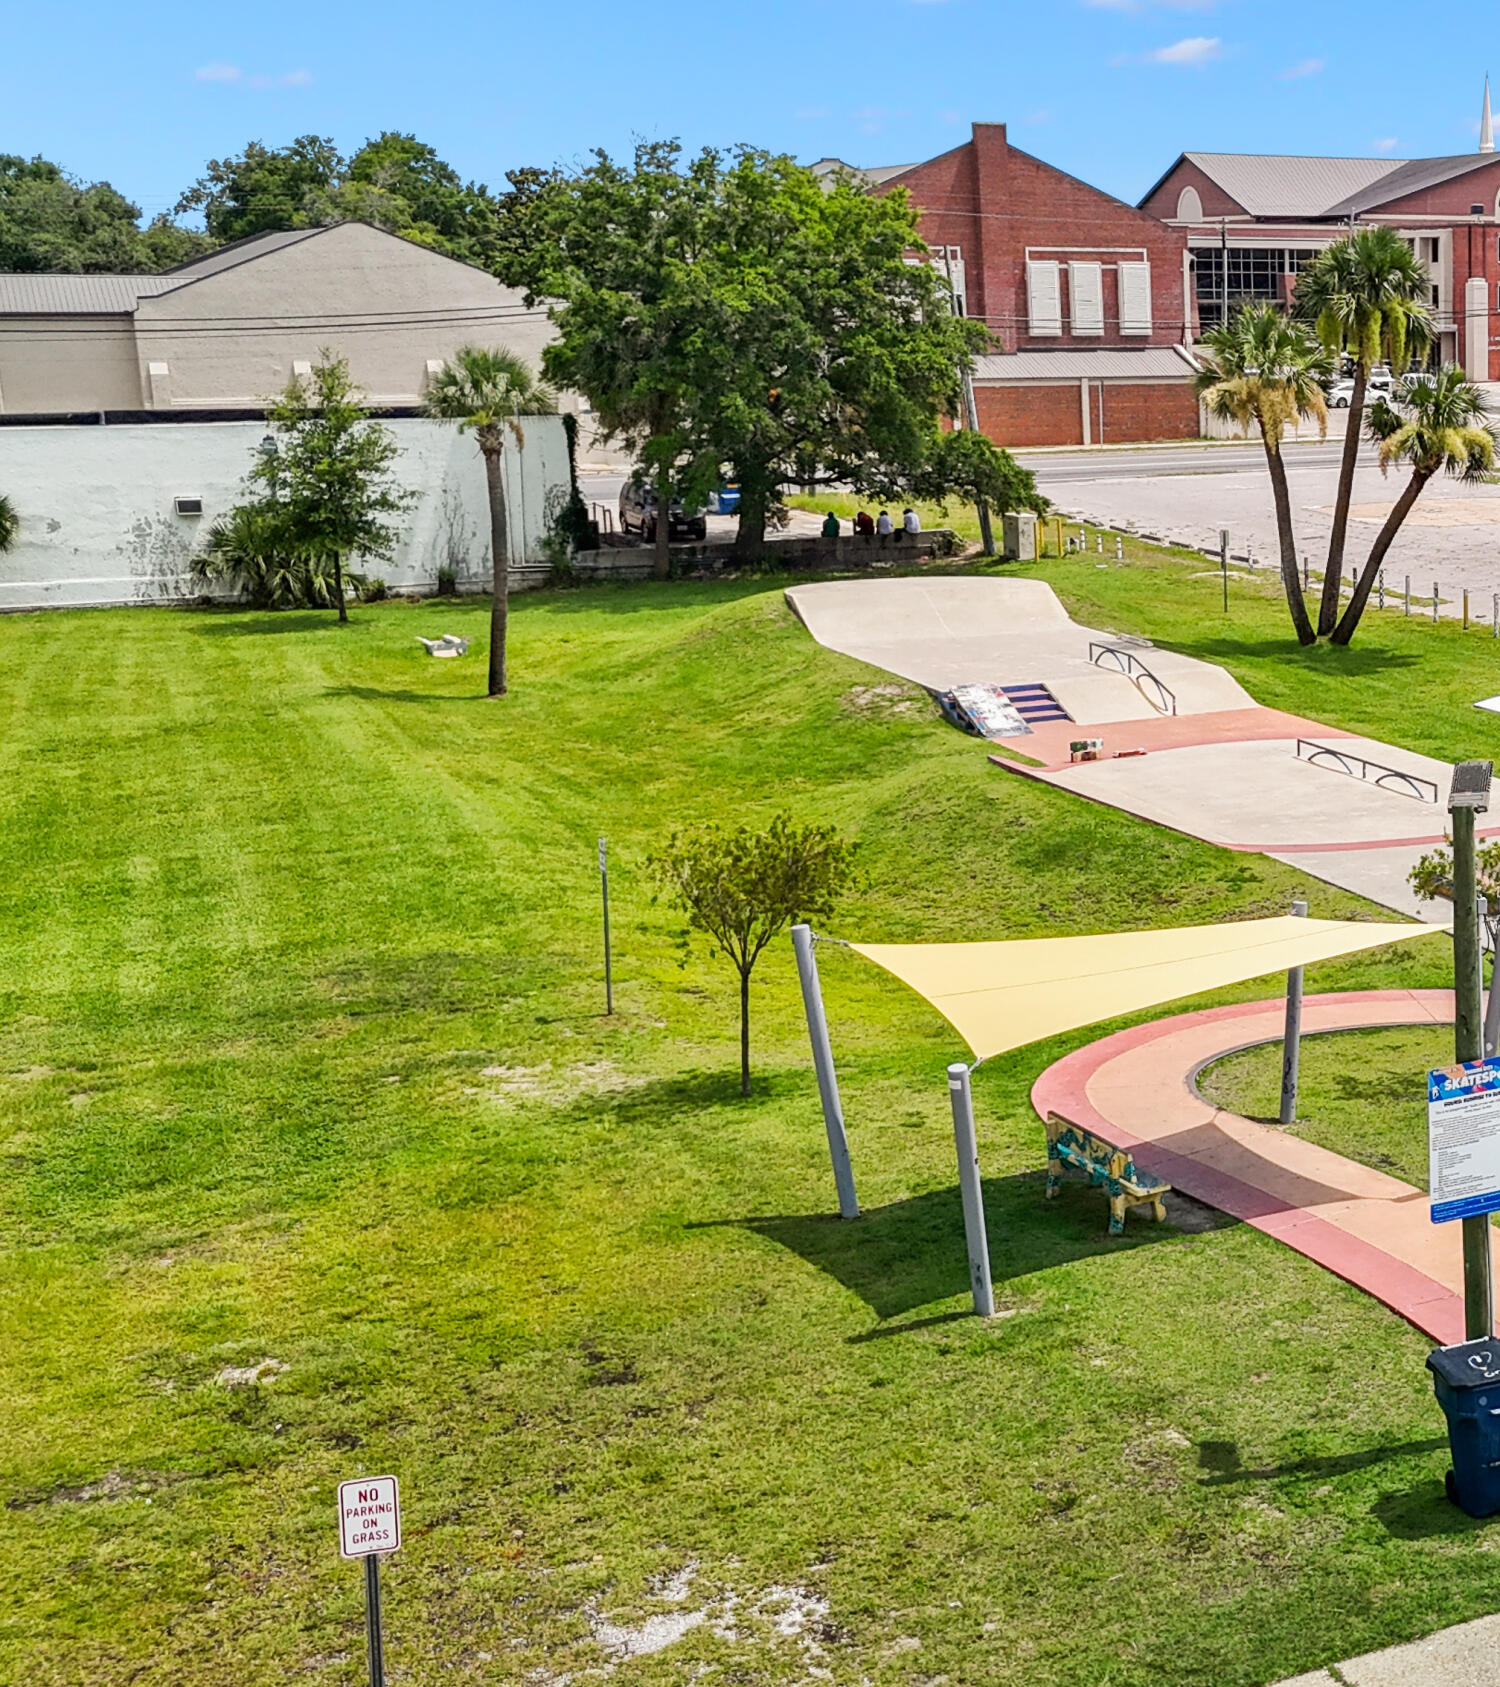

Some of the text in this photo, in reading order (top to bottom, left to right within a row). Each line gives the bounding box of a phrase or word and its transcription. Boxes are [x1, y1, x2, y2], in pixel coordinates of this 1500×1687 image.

[358, 1488, 379, 1503] NO
[346, 1502, 392, 1519] PARKING
[362, 1518, 378, 1529] ON
[352, 1529, 389, 1544] GRASS
